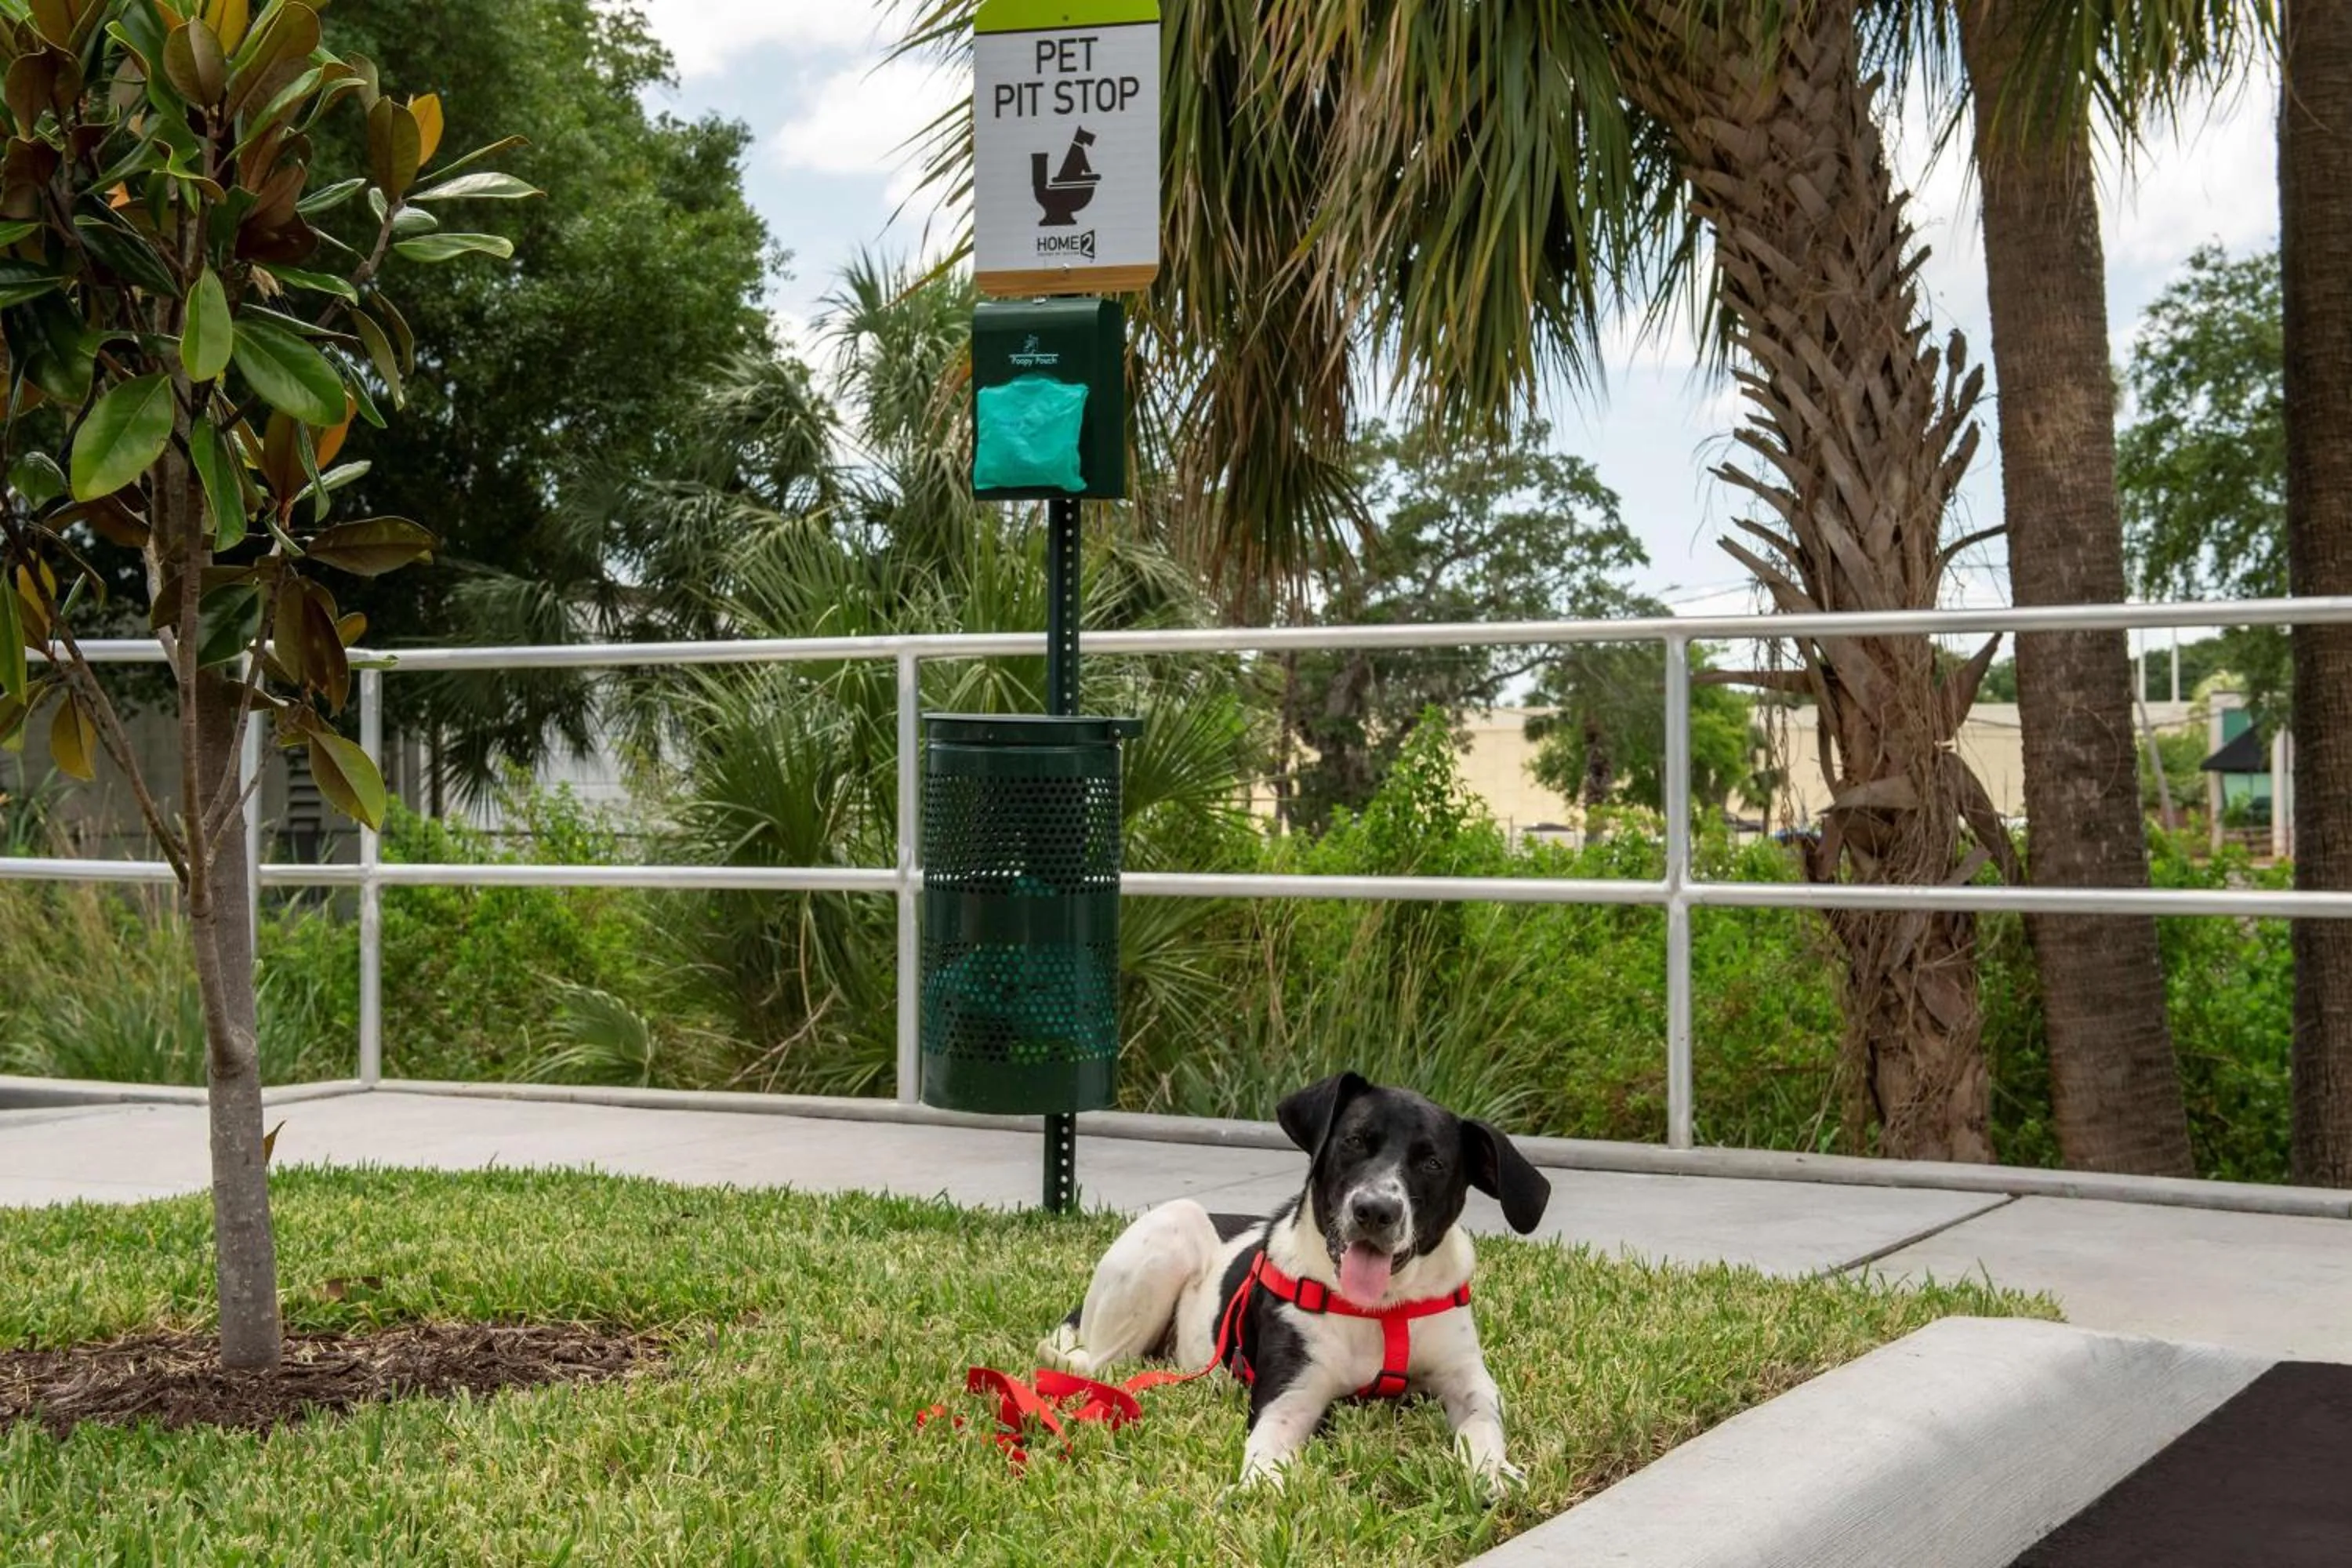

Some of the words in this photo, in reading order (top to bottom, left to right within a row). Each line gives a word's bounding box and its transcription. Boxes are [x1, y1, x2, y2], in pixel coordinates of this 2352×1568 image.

[1036, 37, 1098, 74] PET
[994, 82, 1044, 118] PIT
[1053, 76, 1140, 115] STOP
